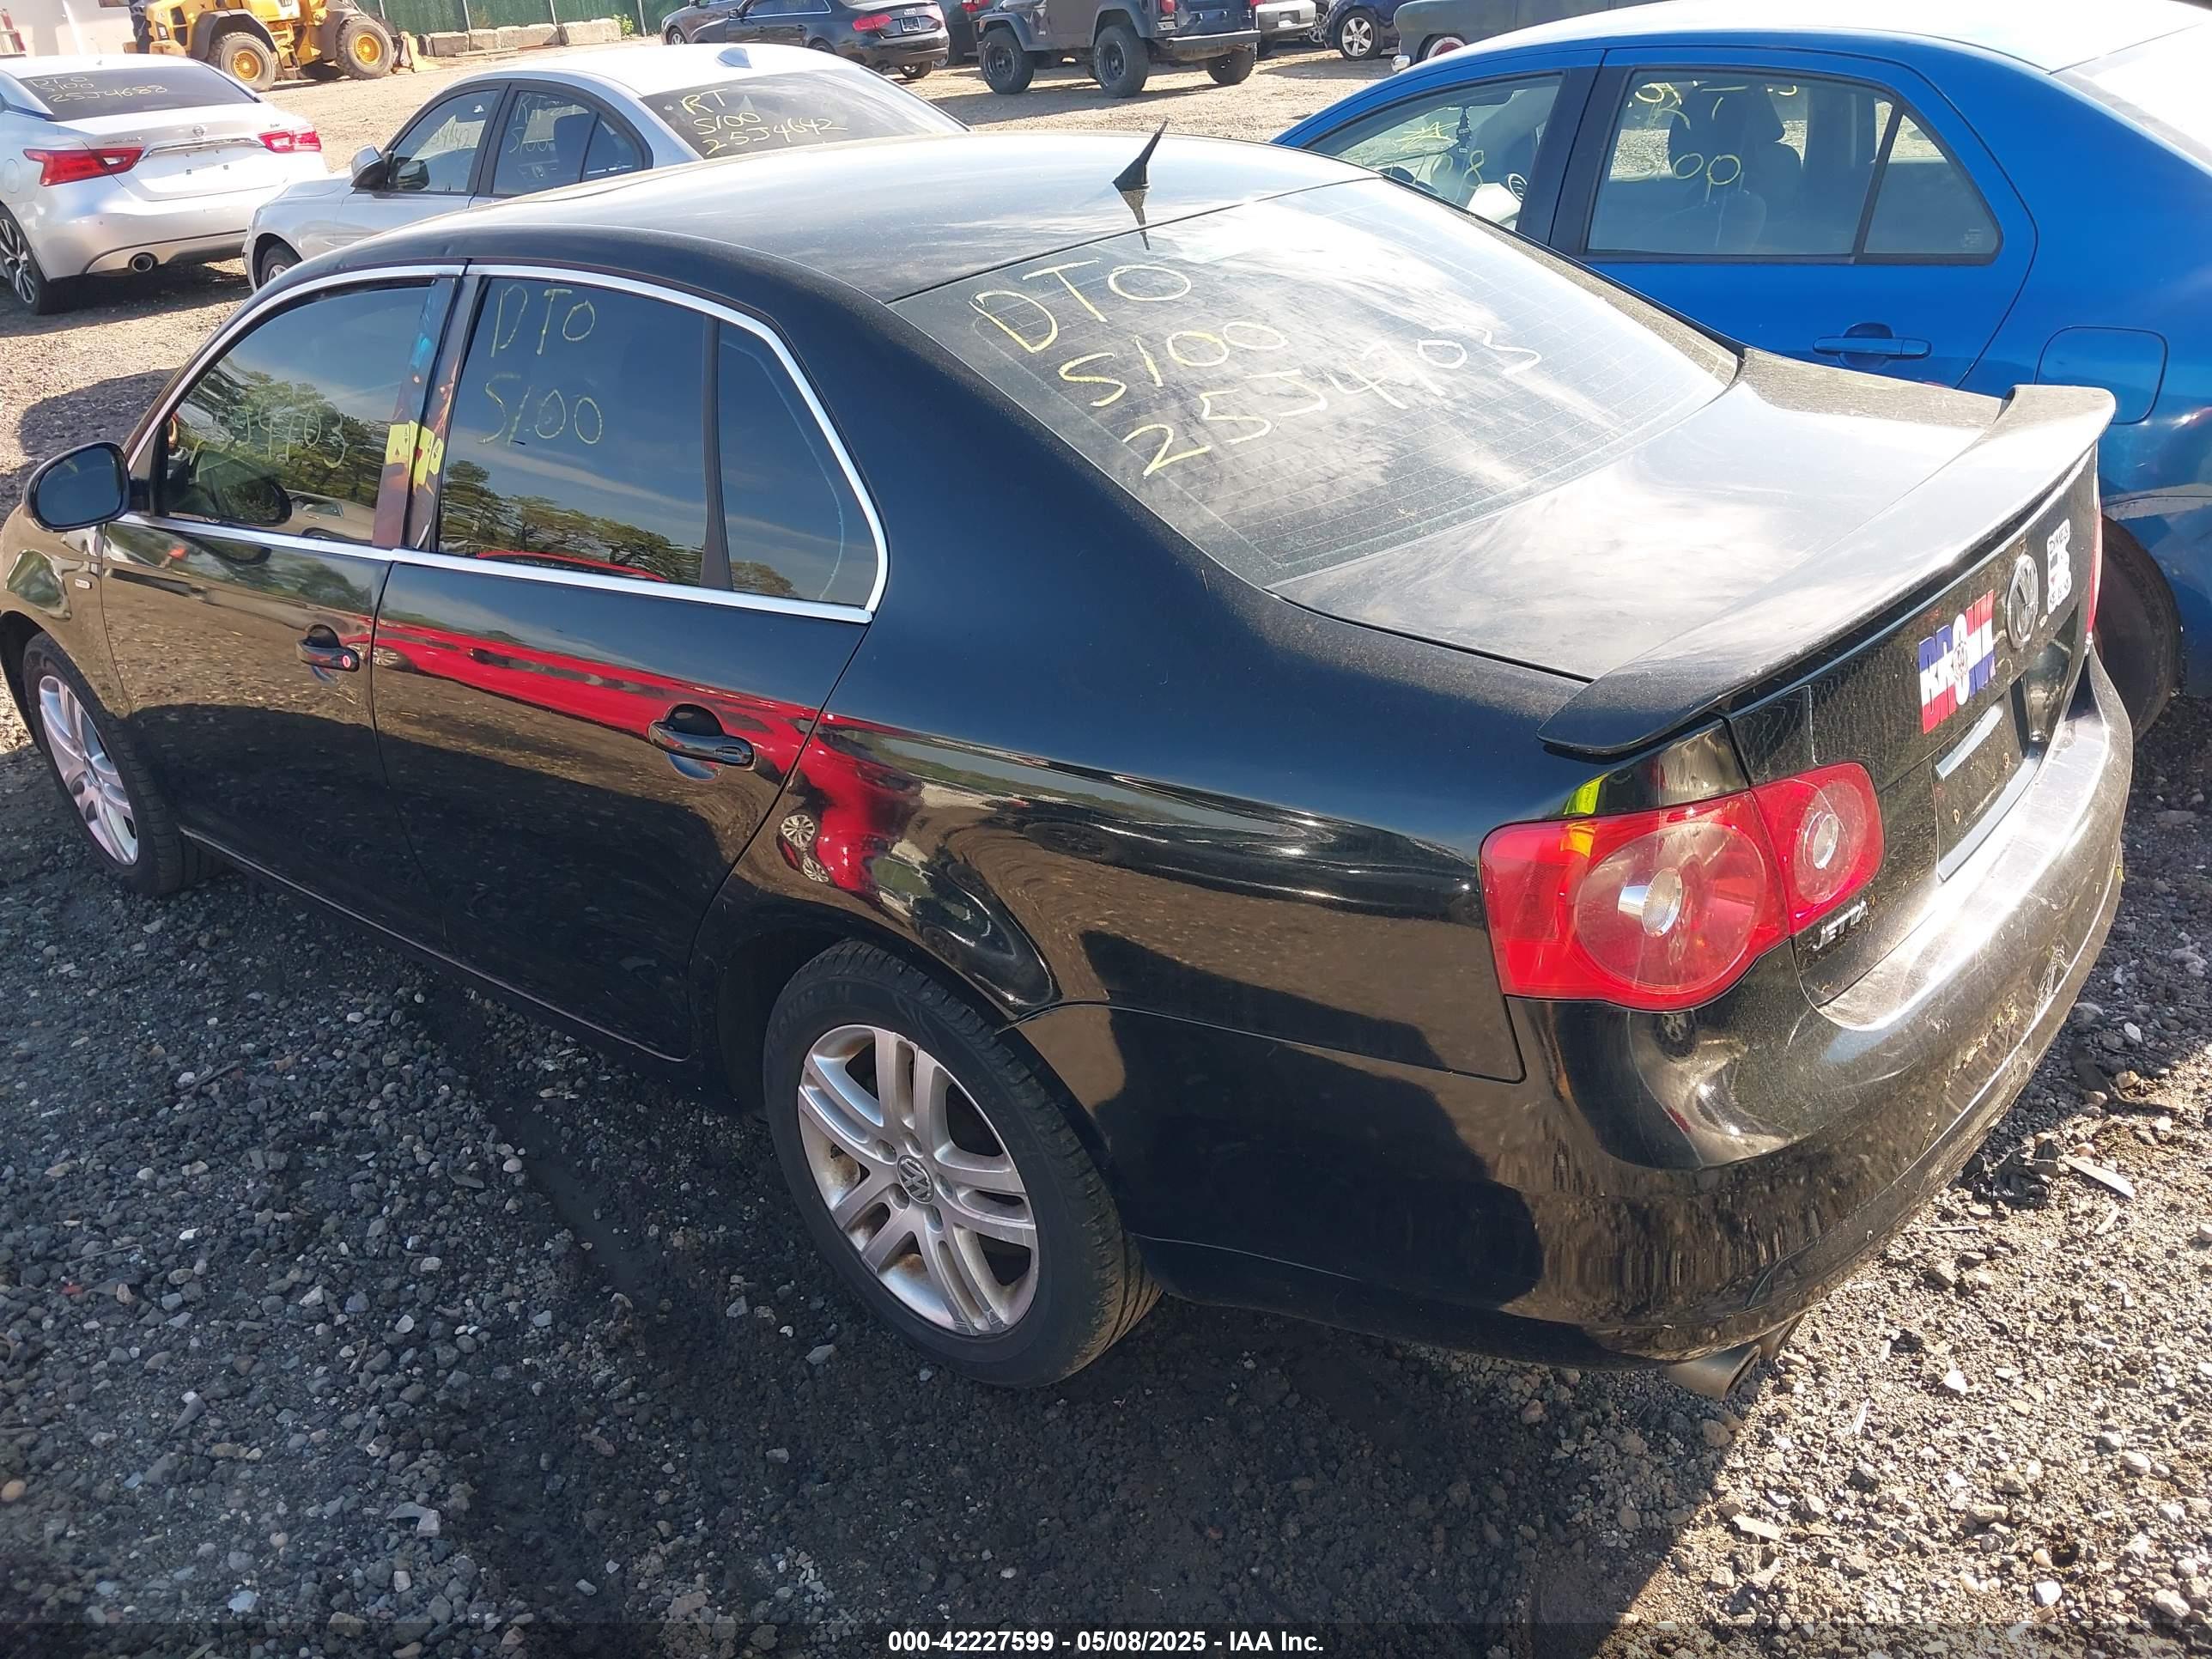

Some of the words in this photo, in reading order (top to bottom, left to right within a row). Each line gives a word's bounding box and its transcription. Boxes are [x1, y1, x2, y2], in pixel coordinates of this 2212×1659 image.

[680, 88, 728, 115] RT
[491, 284, 596, 358] DTO
[969, 260, 1192, 353] DTO
[1812, 896, 1869, 952] JETTA
